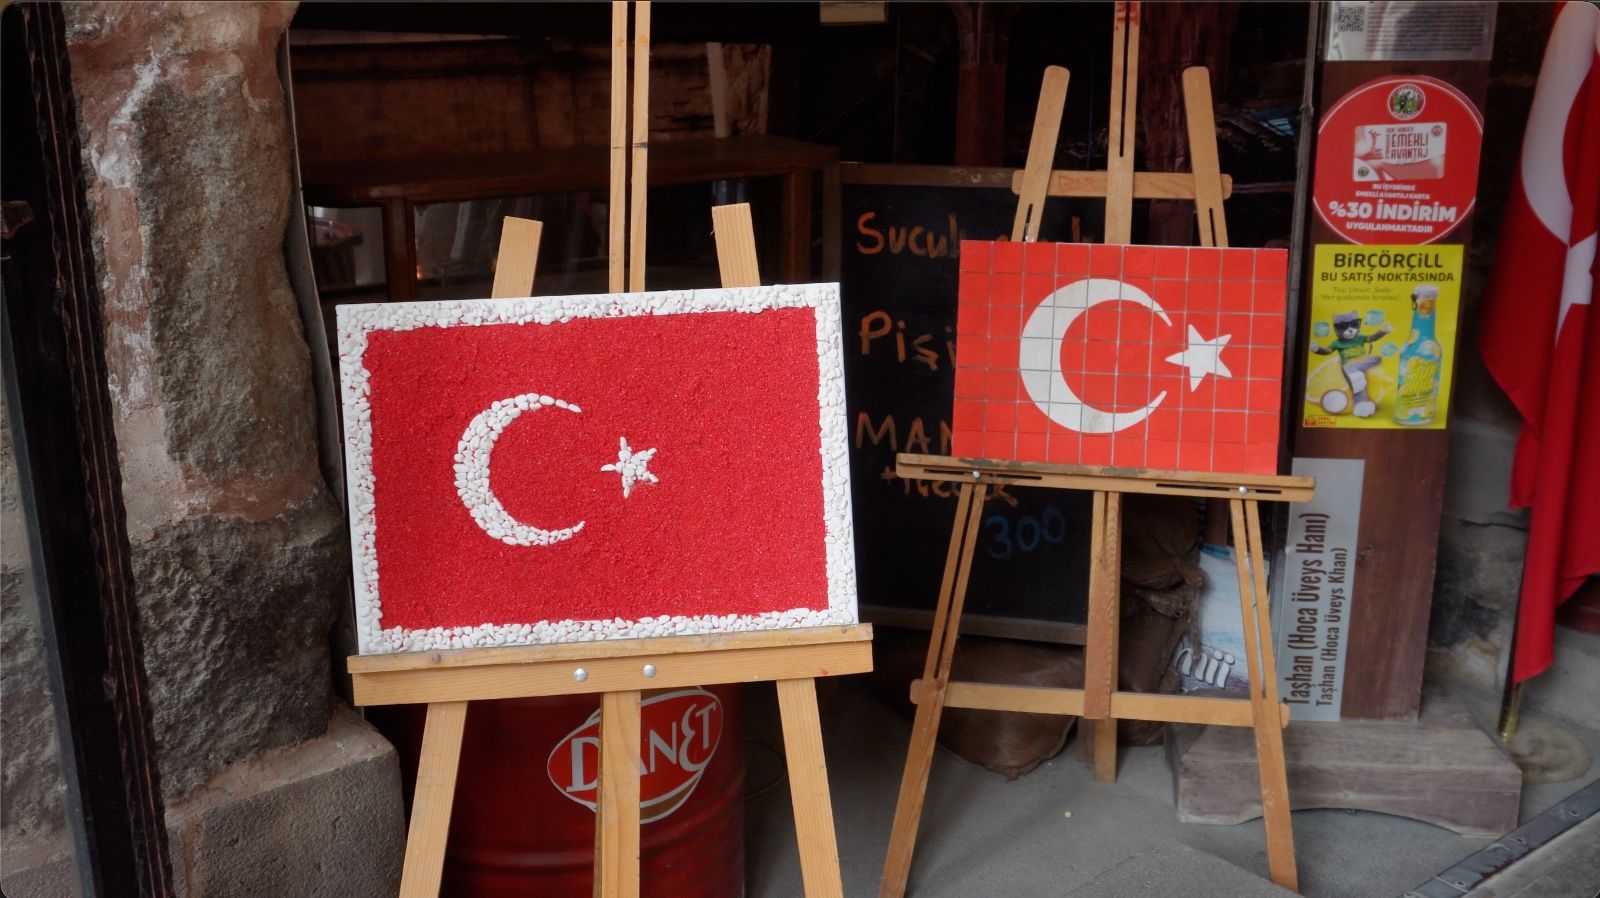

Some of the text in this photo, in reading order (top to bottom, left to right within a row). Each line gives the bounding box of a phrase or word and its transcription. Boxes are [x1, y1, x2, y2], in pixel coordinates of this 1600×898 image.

[1390, 147, 1429, 160] AVANTAJ
[1329, 199, 1457, 222] %30 İNDİRİM
[1379, 191, 1409, 199] AVANTAJ
[855, 210, 961, 259] Sucul
[1346, 221, 1434, 233] UYGULANMAKTADIR
[1321, 272, 1454, 284] BU SATIŞ NOKTASINDA
[983, 504, 1067, 561] 300
[1283, 512, 1331, 705] Taşhan (Hoca Üveys Hanı)
[1316, 547, 1348, 707] Taşhan (Hoca Üveys Khan)
[565, 700, 718, 793] DNET
